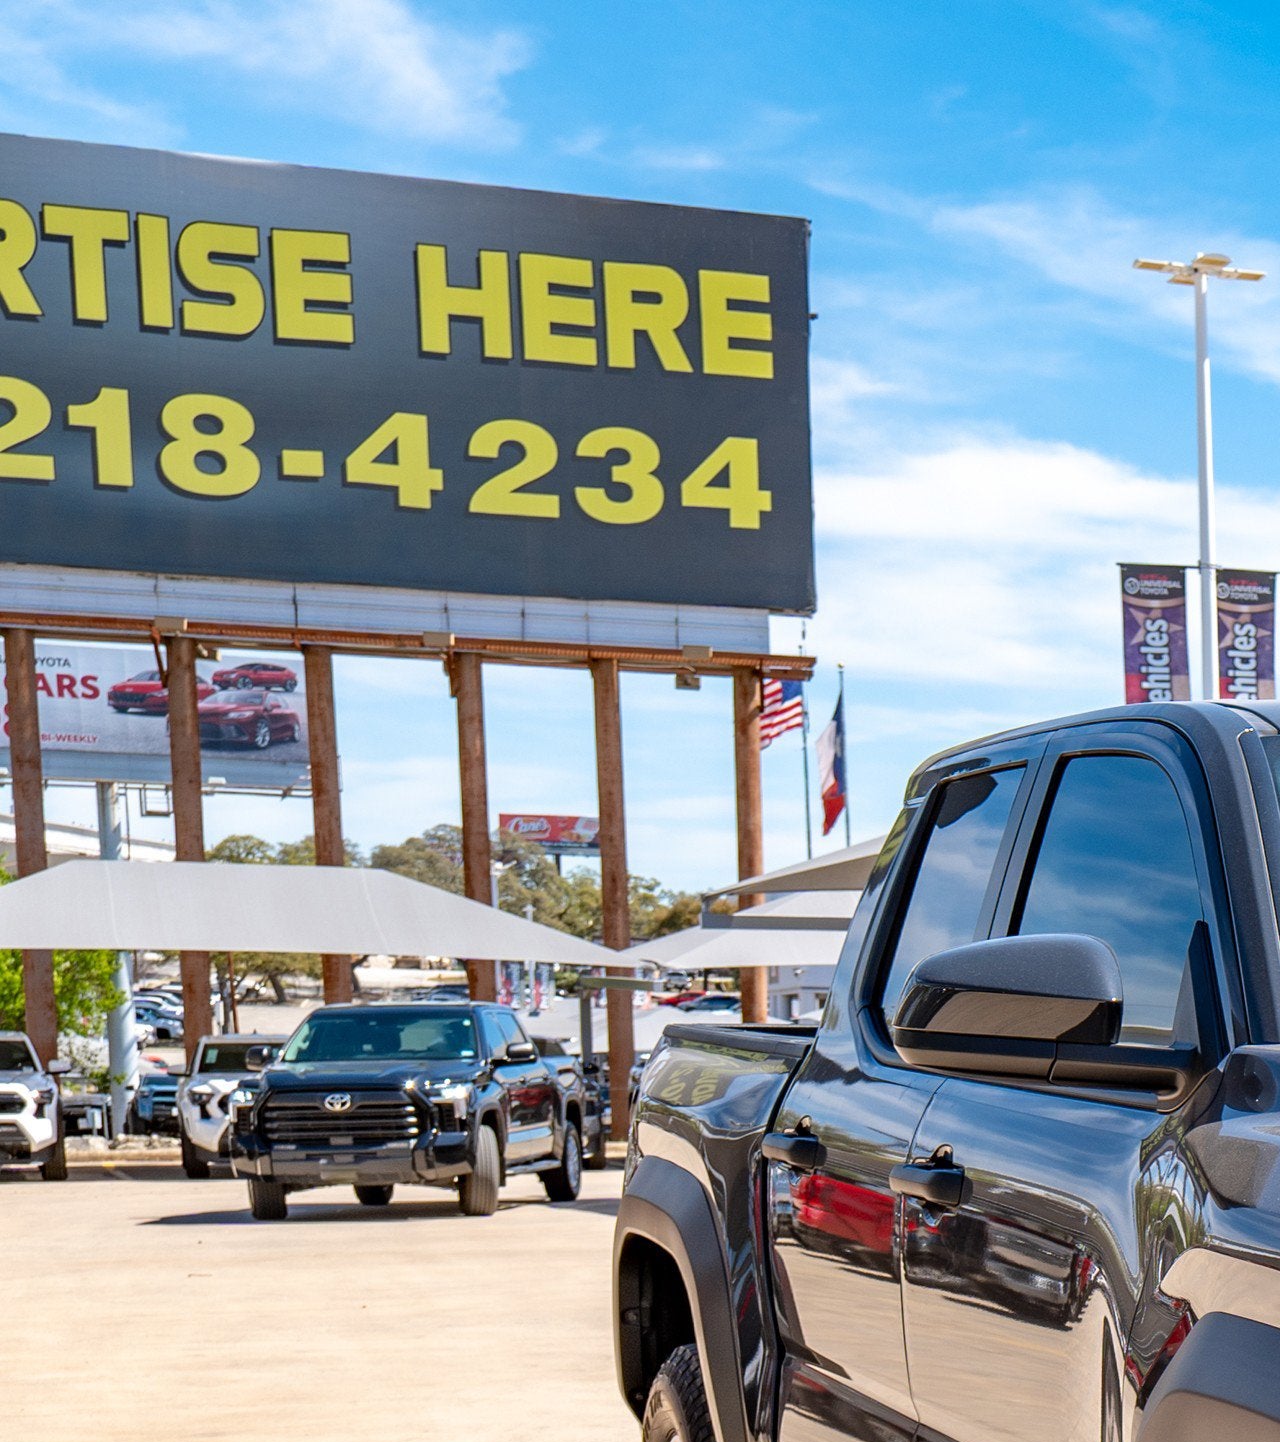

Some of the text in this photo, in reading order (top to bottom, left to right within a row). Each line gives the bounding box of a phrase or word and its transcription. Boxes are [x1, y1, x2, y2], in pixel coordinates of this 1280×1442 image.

[415, 242, 774, 379] HERE
[0, 375, 773, 530] 218-4234
[4, 673, 100, 699] ARS
[35, 656, 71, 668] YOTA
[1140, 618, 1173, 701] ehicles
[1227, 623, 1258, 700] ehicles
